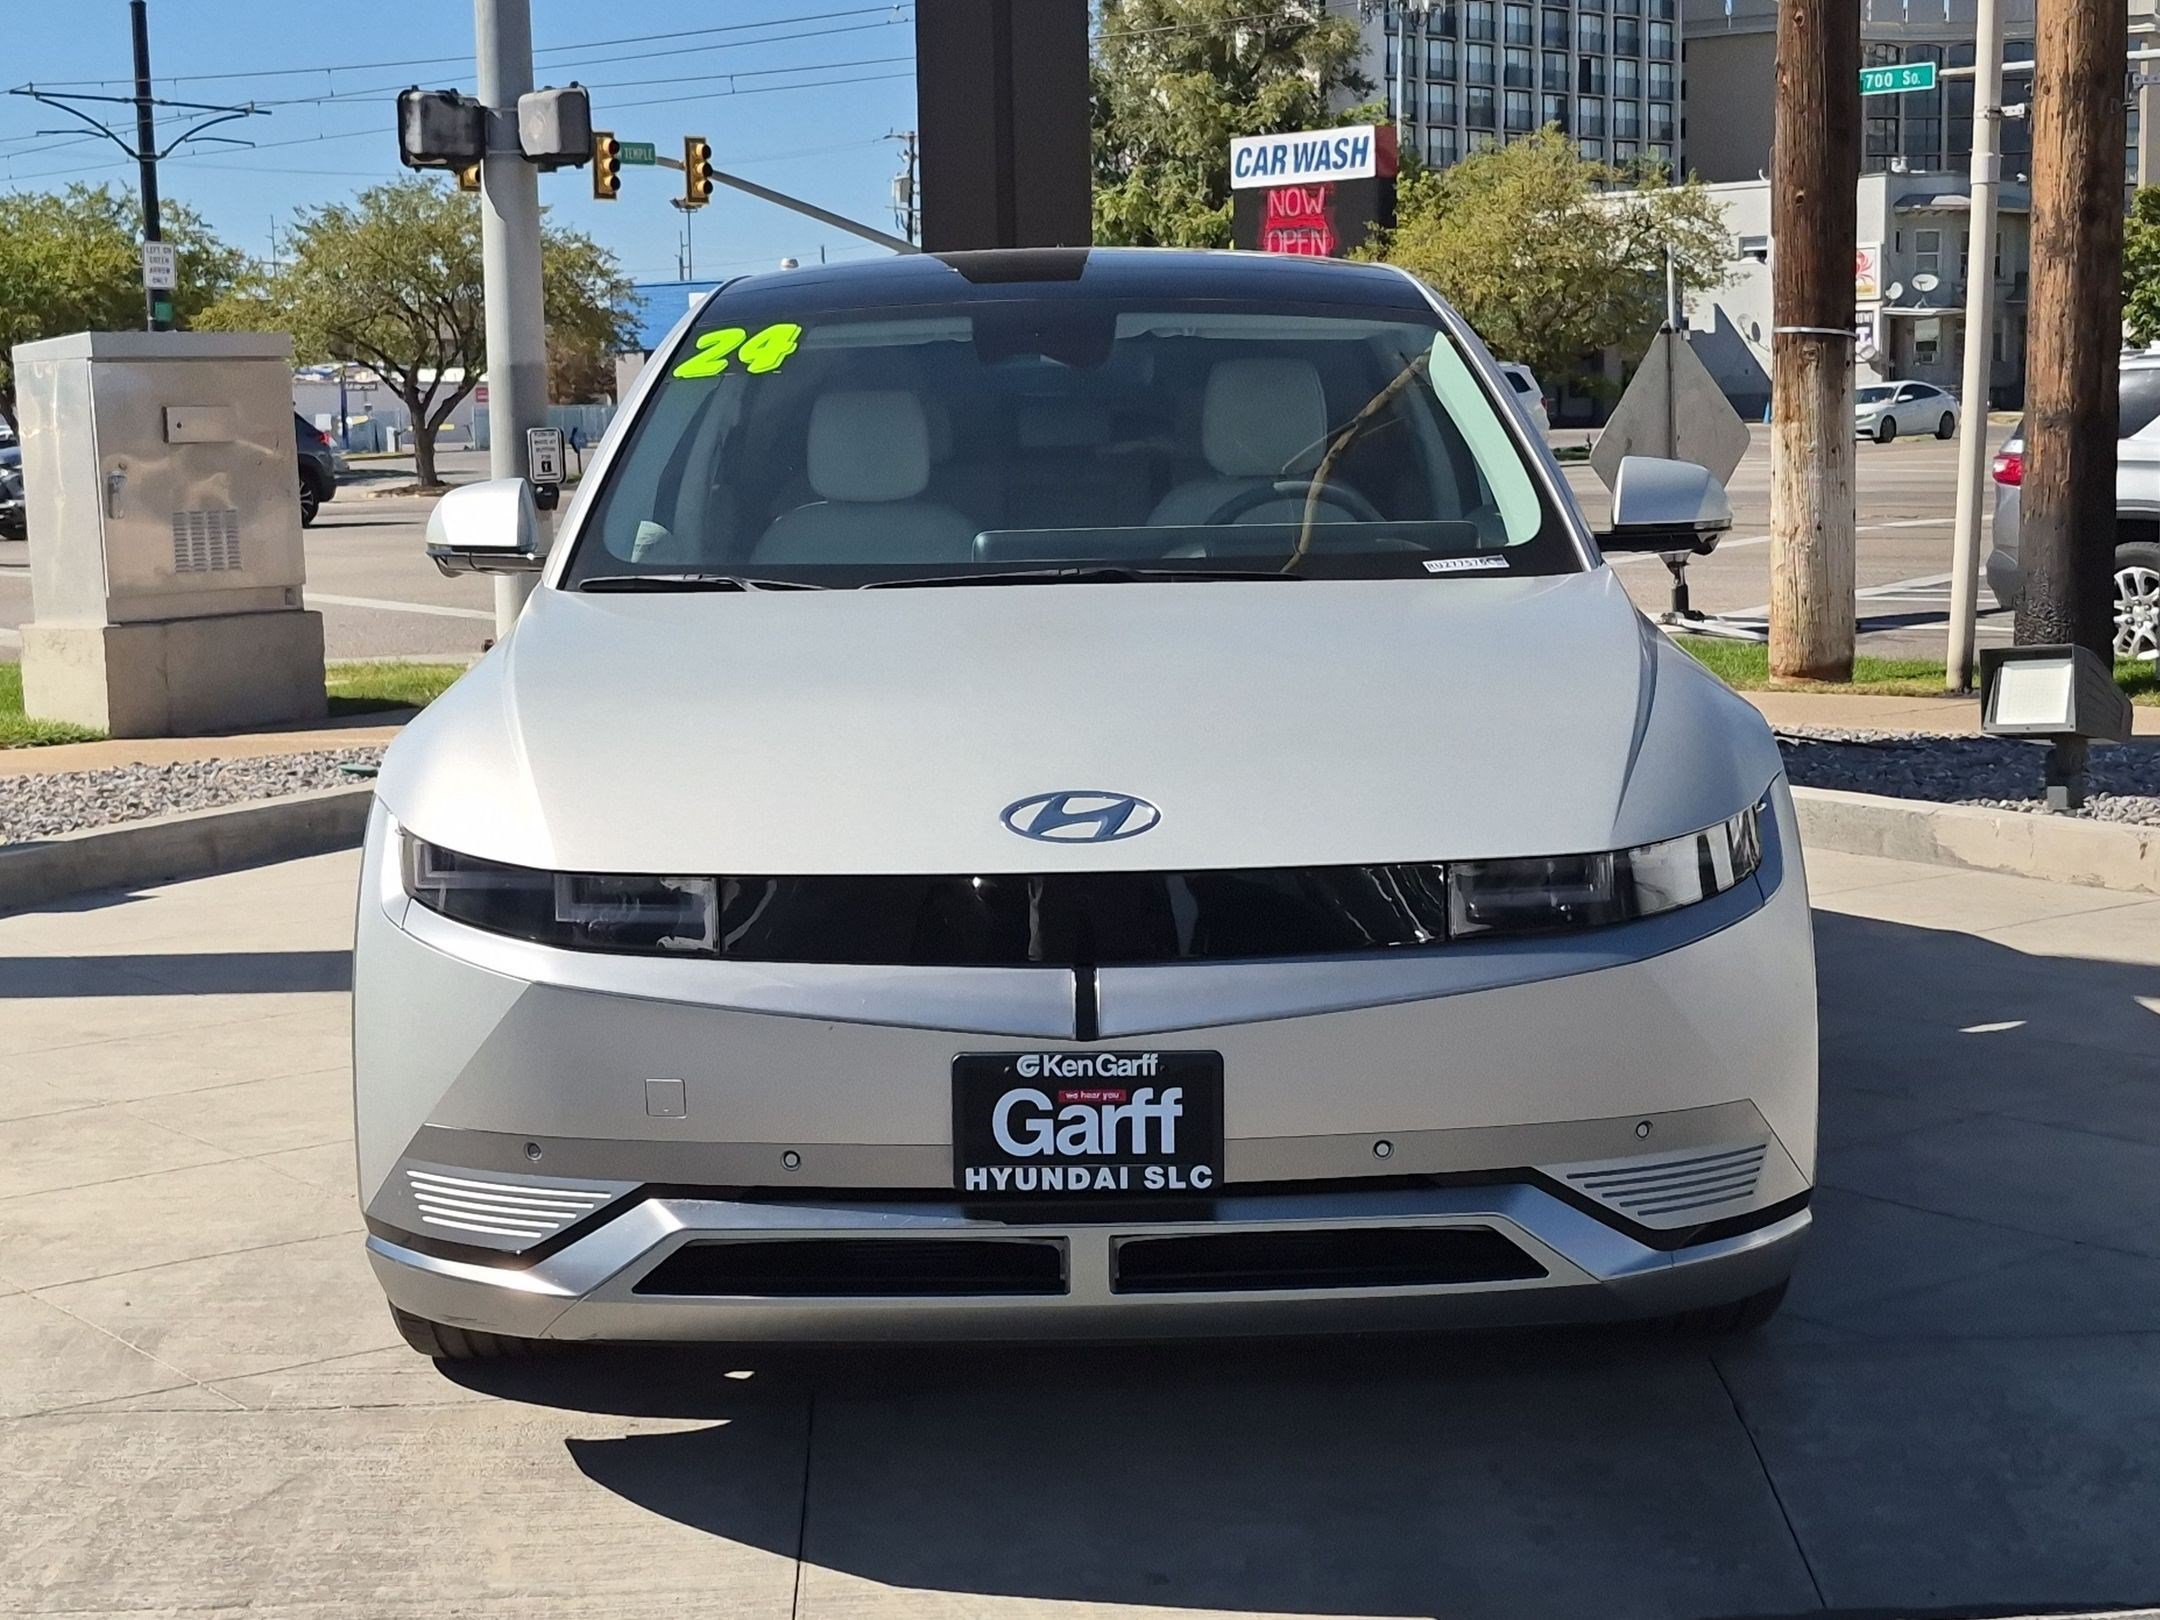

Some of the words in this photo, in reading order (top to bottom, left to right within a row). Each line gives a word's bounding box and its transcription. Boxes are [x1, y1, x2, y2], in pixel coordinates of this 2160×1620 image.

[1865, 72, 1893, 89] 700
[623, 147, 653, 161] TEMPLE
[1235, 144, 1287, 178] CAR
[1293, 135, 1370, 173] WASH
[1269, 186, 1325, 217] NOW
[1267, 228, 1328, 256] OPEN
[673, 323, 802, 378] 24
[1043, 1054, 1093, 1076] Ken
[1096, 1053, 1159, 1078] Garff
[1080, 1091, 1100, 1099] hear
[1102, 1092, 1120, 1101] you
[992, 1087, 1183, 1157] Garff
[965, 1167, 1129, 1191] HYUNDAI
[1143, 1165, 1213, 1189] SLC
